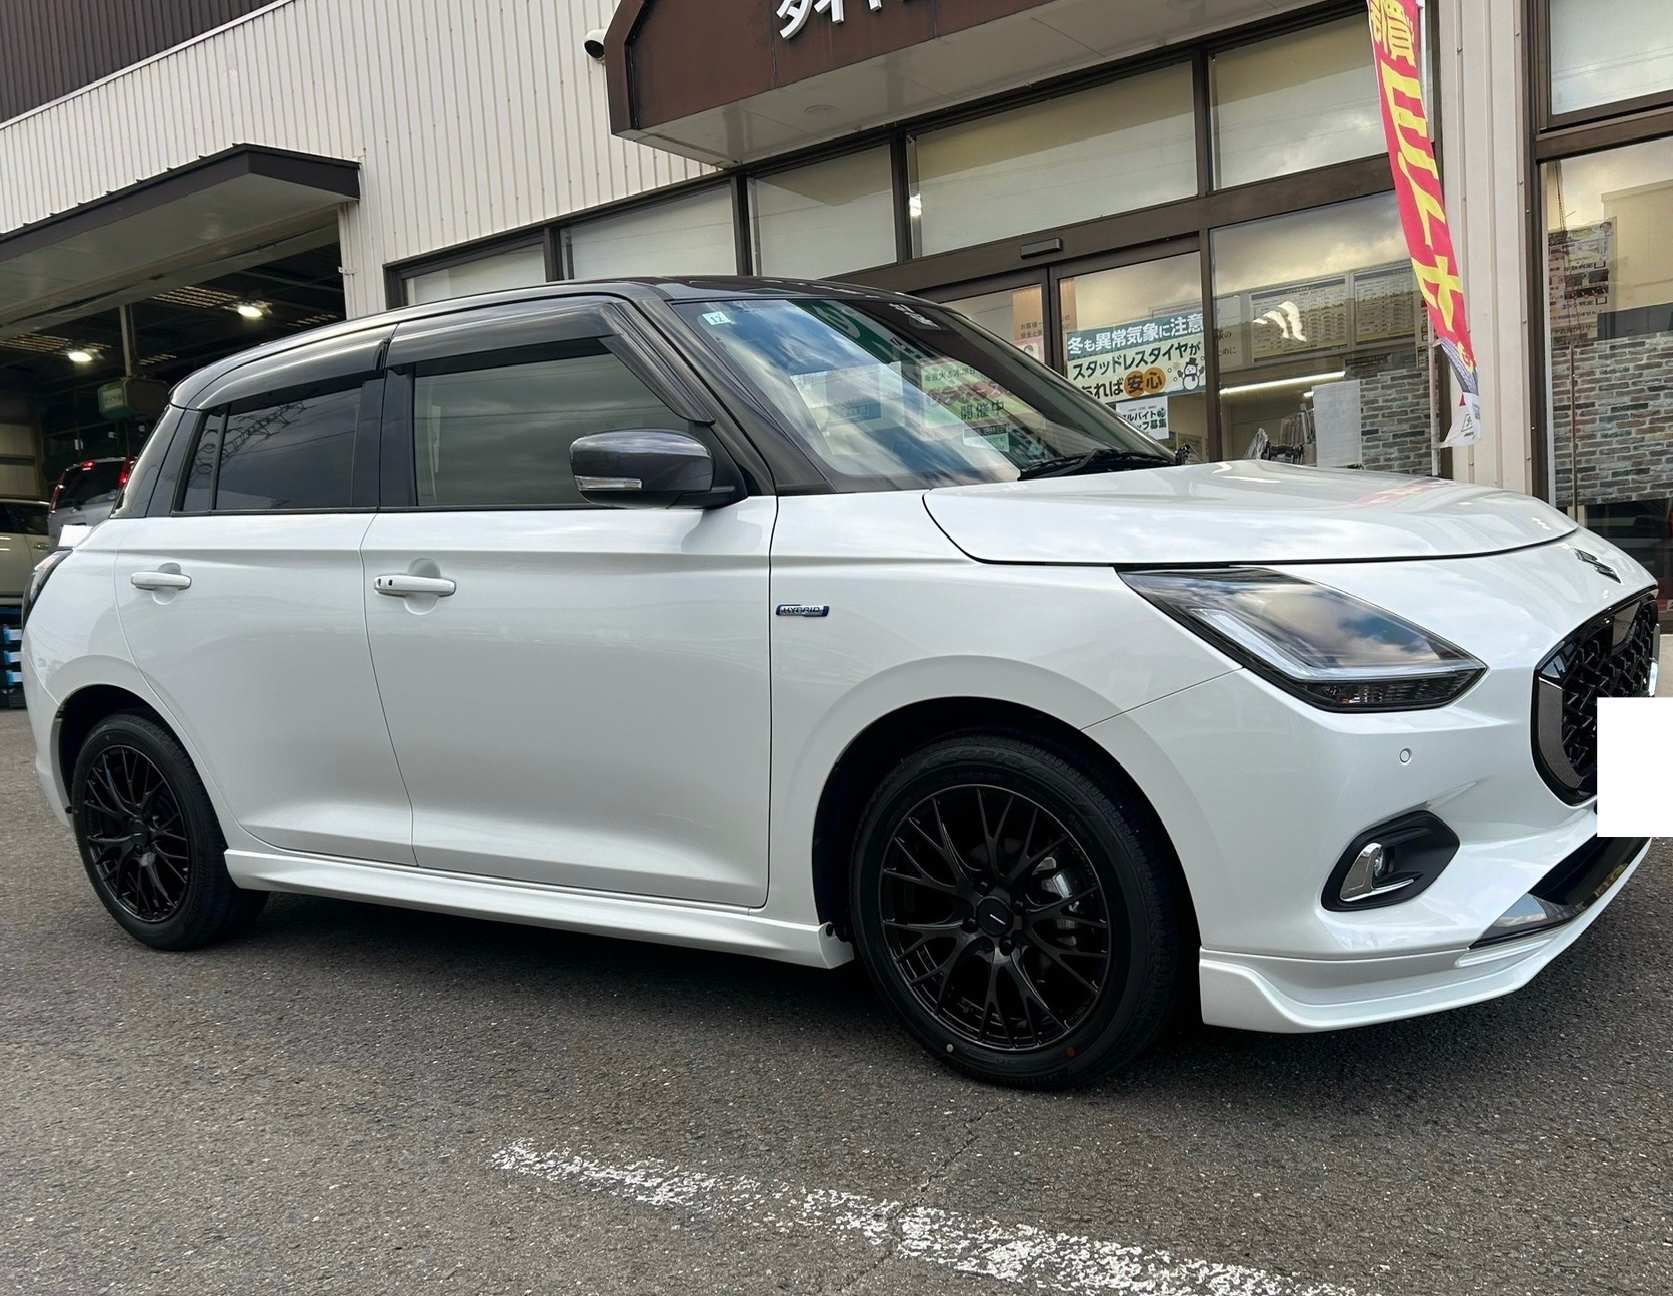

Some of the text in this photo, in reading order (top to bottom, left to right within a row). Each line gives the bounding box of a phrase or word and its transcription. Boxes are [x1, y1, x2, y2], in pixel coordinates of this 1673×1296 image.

[1067, 312, 1204, 354] 冬も異常気象に注意
[1072, 341, 1202, 381] スタッドレスタイヤが
[960, 400, 1004, 421] 開催中
[782, 606, 821, 614] HYBRID
